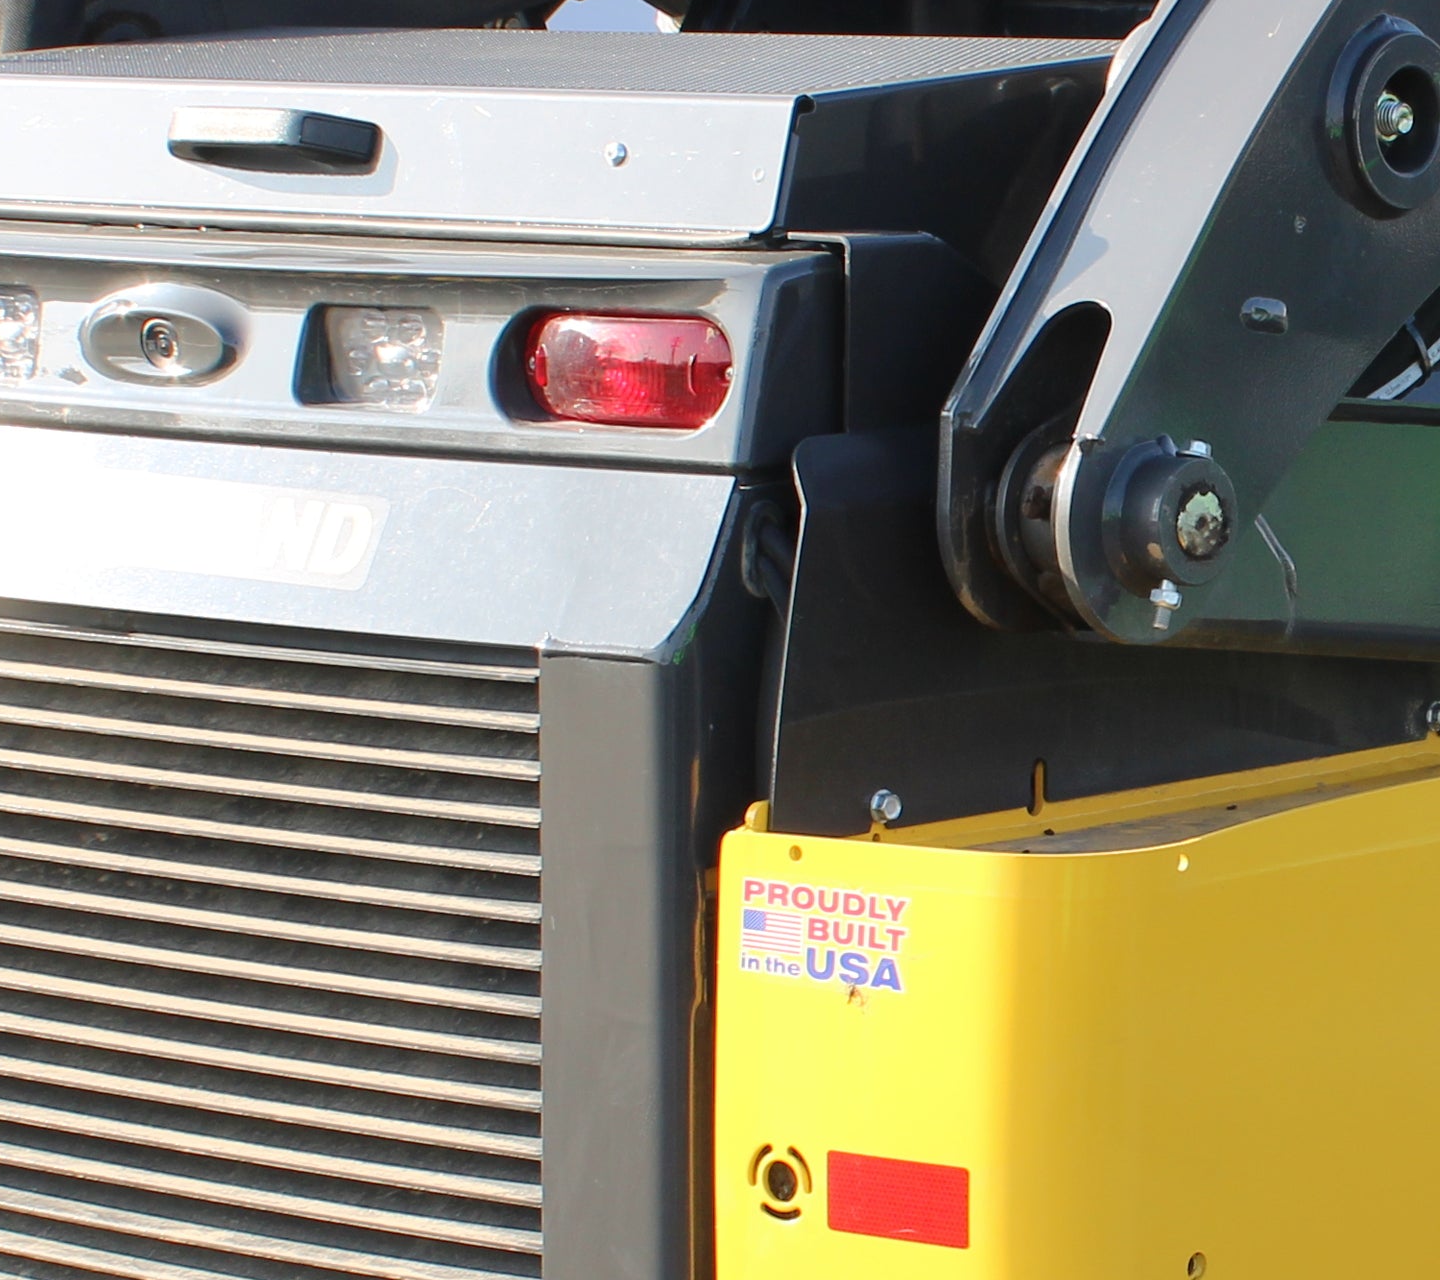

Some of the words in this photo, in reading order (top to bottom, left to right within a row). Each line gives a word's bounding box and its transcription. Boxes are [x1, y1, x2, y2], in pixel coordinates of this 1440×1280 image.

[744, 880, 906, 921] PROUDLY
[808, 918, 906, 951] BUILT
[740, 952, 760, 971] in
[765, 955, 801, 976] the
[806, 947, 902, 991] USA
